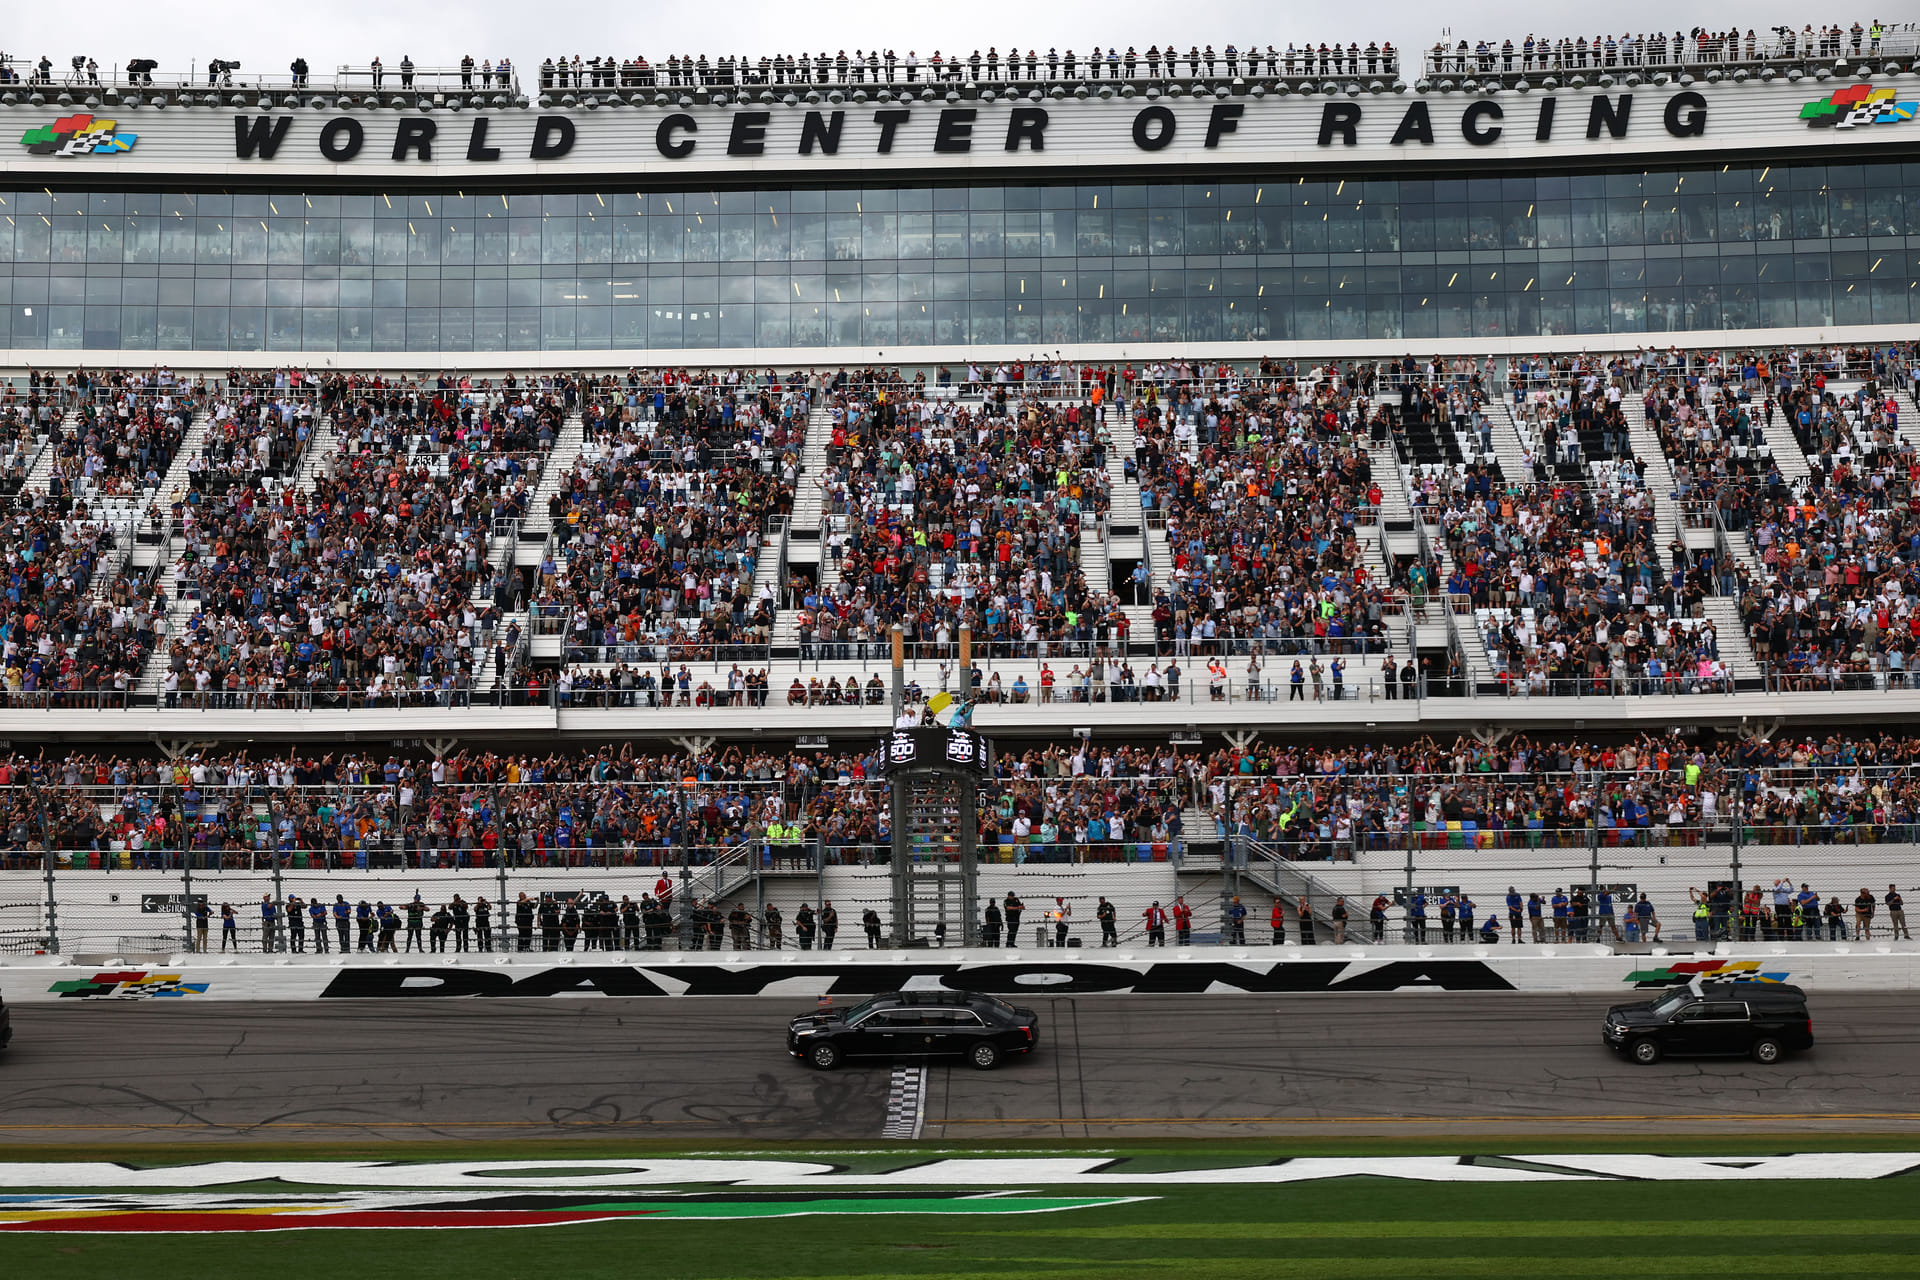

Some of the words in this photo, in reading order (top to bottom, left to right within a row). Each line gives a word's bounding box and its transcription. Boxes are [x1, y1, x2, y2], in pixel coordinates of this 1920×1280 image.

[235, 115, 575, 162] WORLD
[656, 107, 1049, 159] CENTER
[1132, 103, 1244, 151] OF
[1317, 91, 1707, 146] RACING
[798, 735, 808, 744] 147
[890, 743, 914, 757] 500
[949, 742, 973, 756] 500
[168, 894, 181, 904] ALL
[157, 904, 188, 913] SECTION
[319, 961, 1518, 998] DAYTONA
